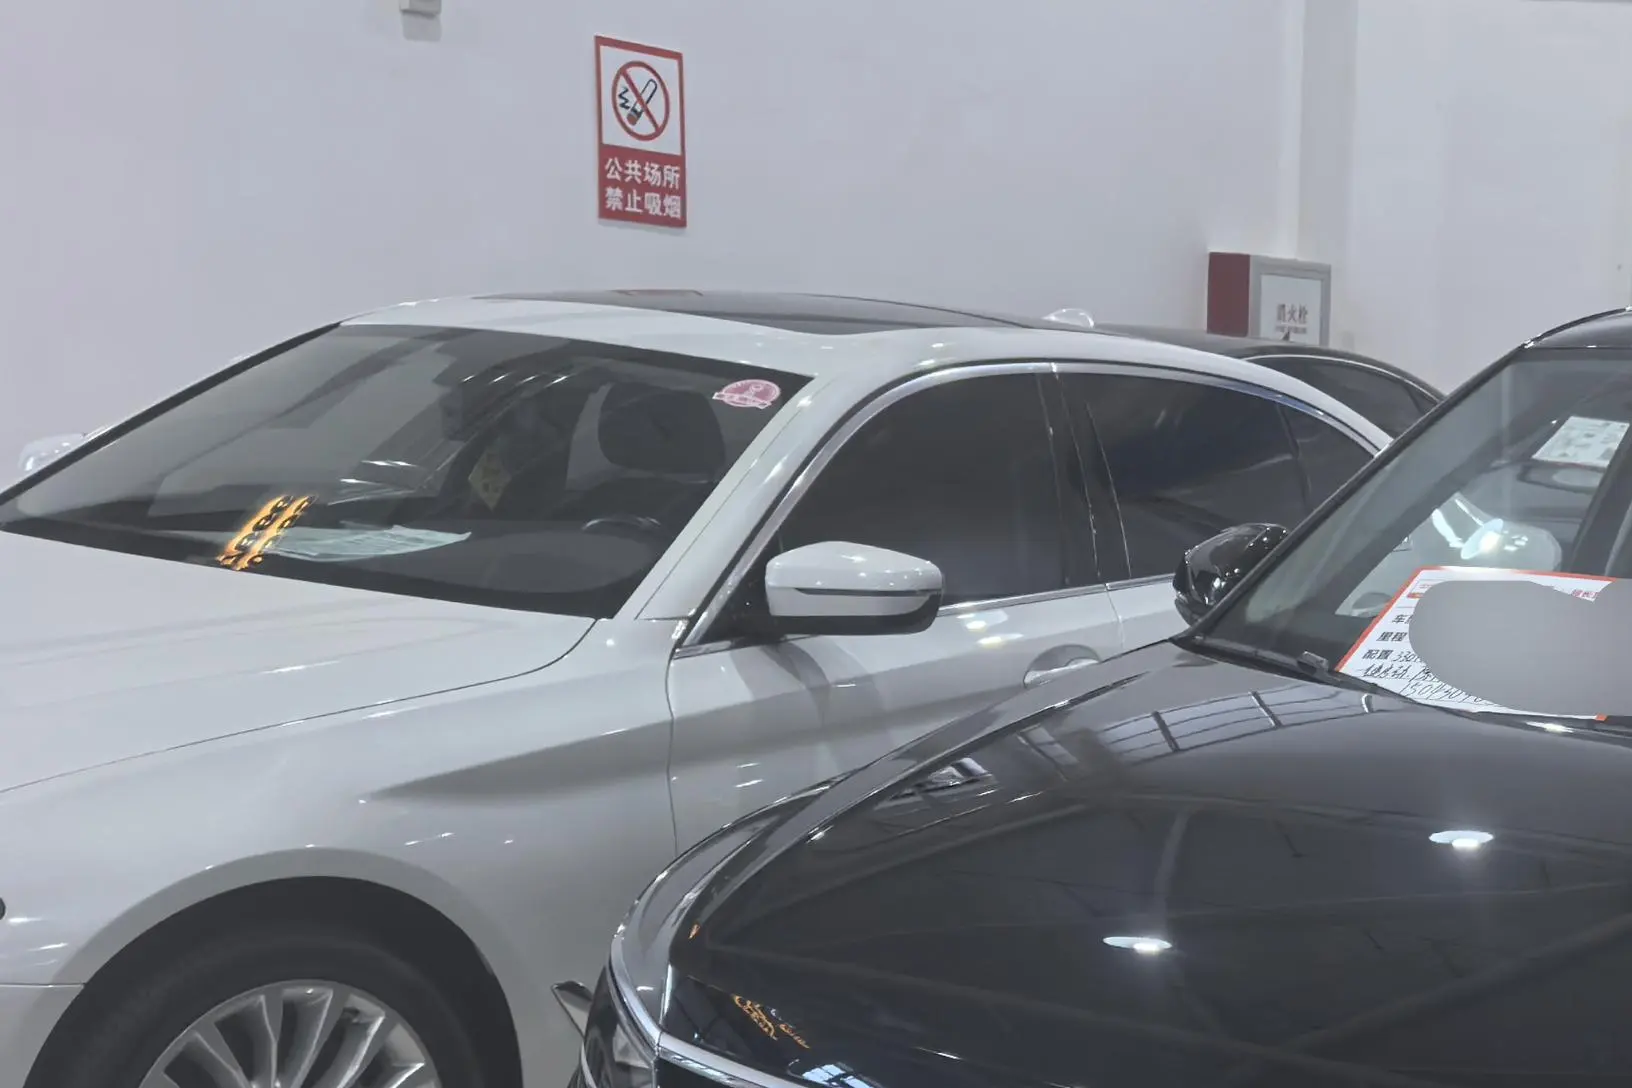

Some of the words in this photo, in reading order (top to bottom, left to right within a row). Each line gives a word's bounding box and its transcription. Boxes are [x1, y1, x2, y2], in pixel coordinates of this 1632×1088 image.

[604, 157, 681, 190] 公共场所
[604, 185, 682, 219] 禁止吸烟
[1361, 649, 1394, 660] 配置
